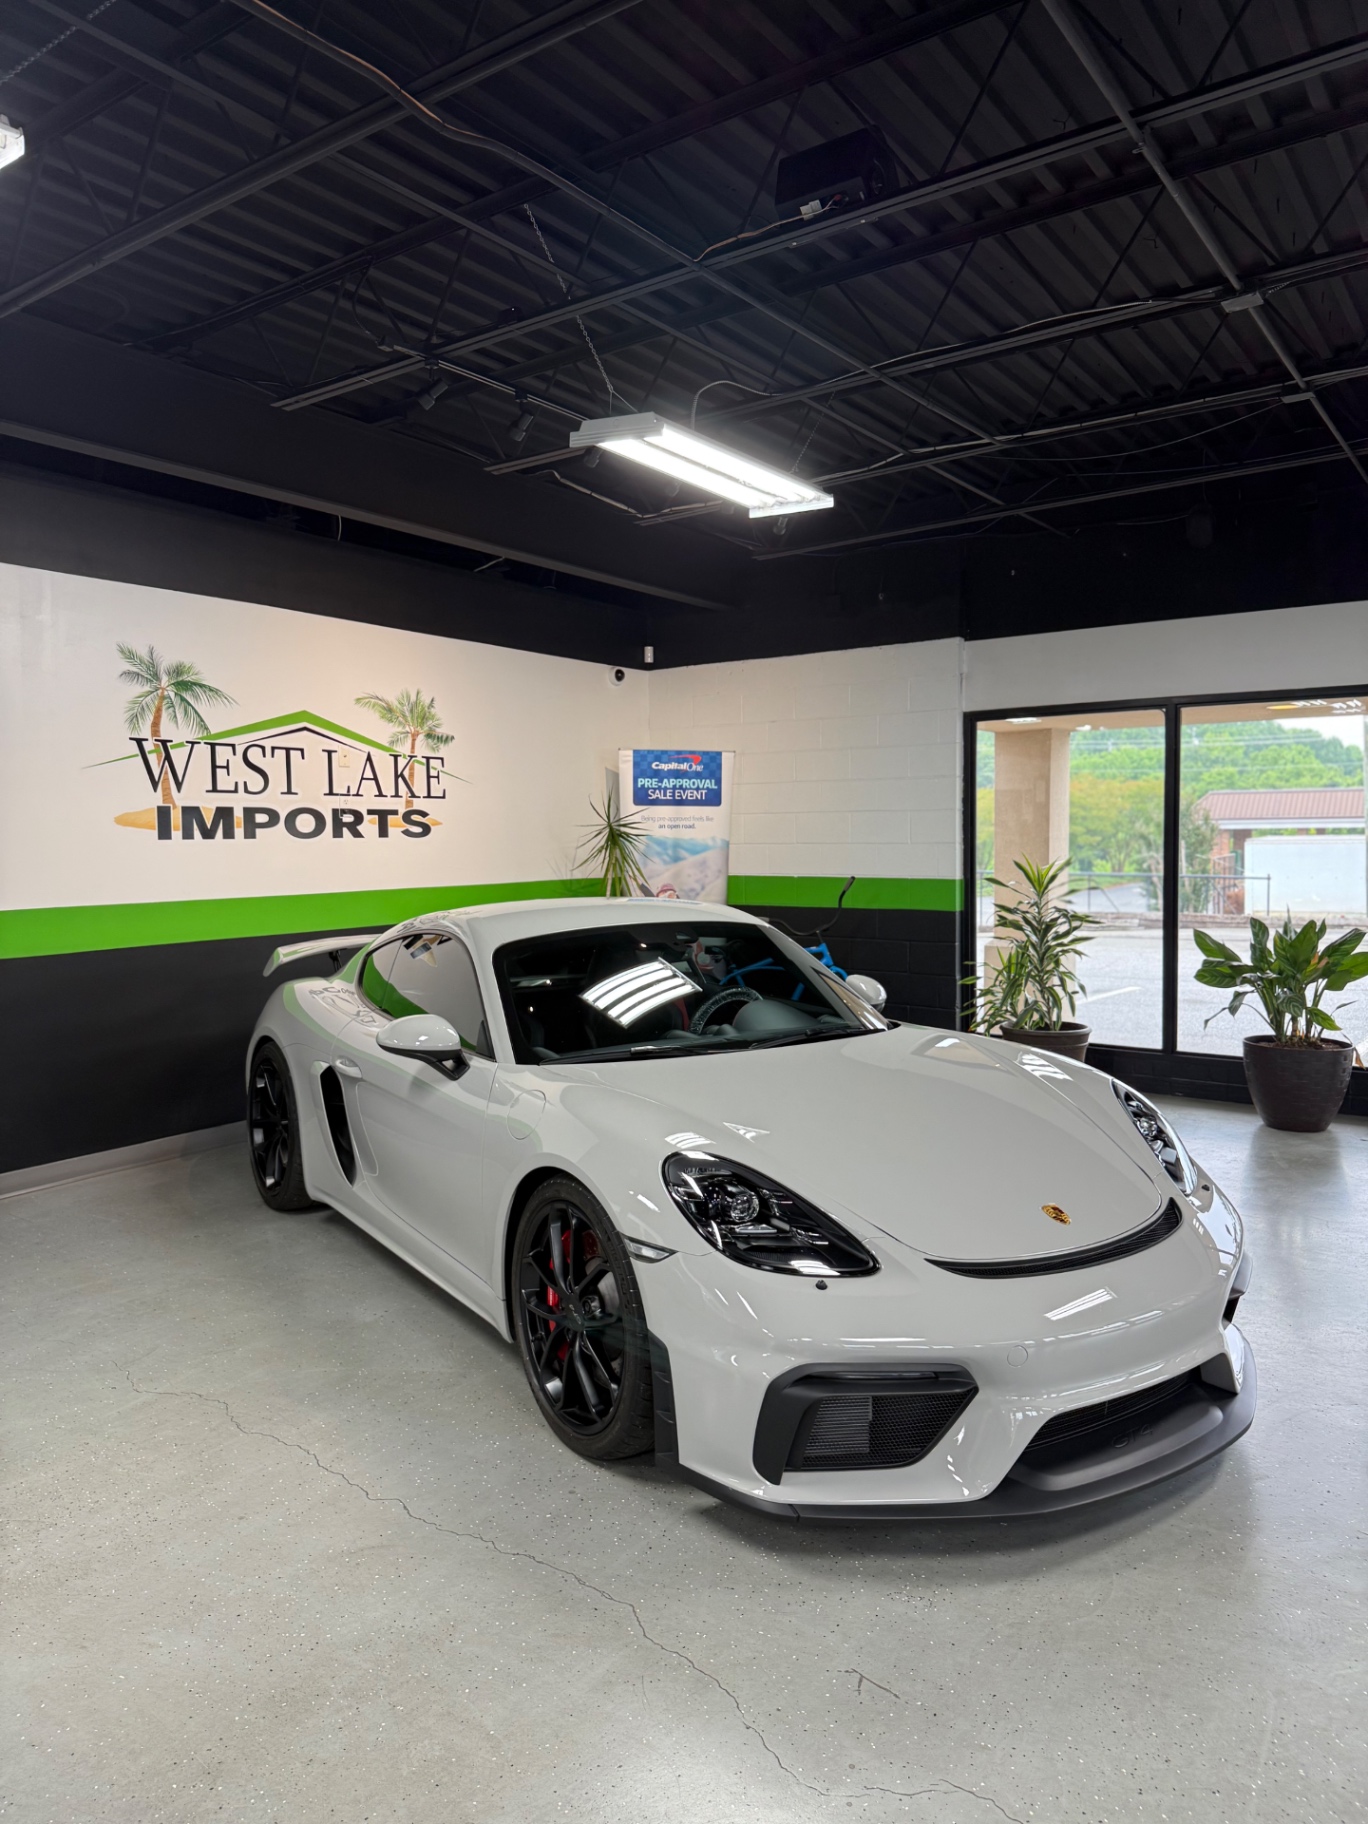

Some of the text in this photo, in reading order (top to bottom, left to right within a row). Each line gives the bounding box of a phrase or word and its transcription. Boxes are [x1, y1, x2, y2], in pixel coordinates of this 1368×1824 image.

[129, 737, 446, 799] WEST LAKE
[637, 778, 718, 789] PRE-APPROVAL
[648, 789, 707, 800] SALE EVENT
[156, 805, 432, 840] IMPORTS
[657, 815, 692, 823] pre-approved
[1111, 1423, 1154, 1448] GT4
